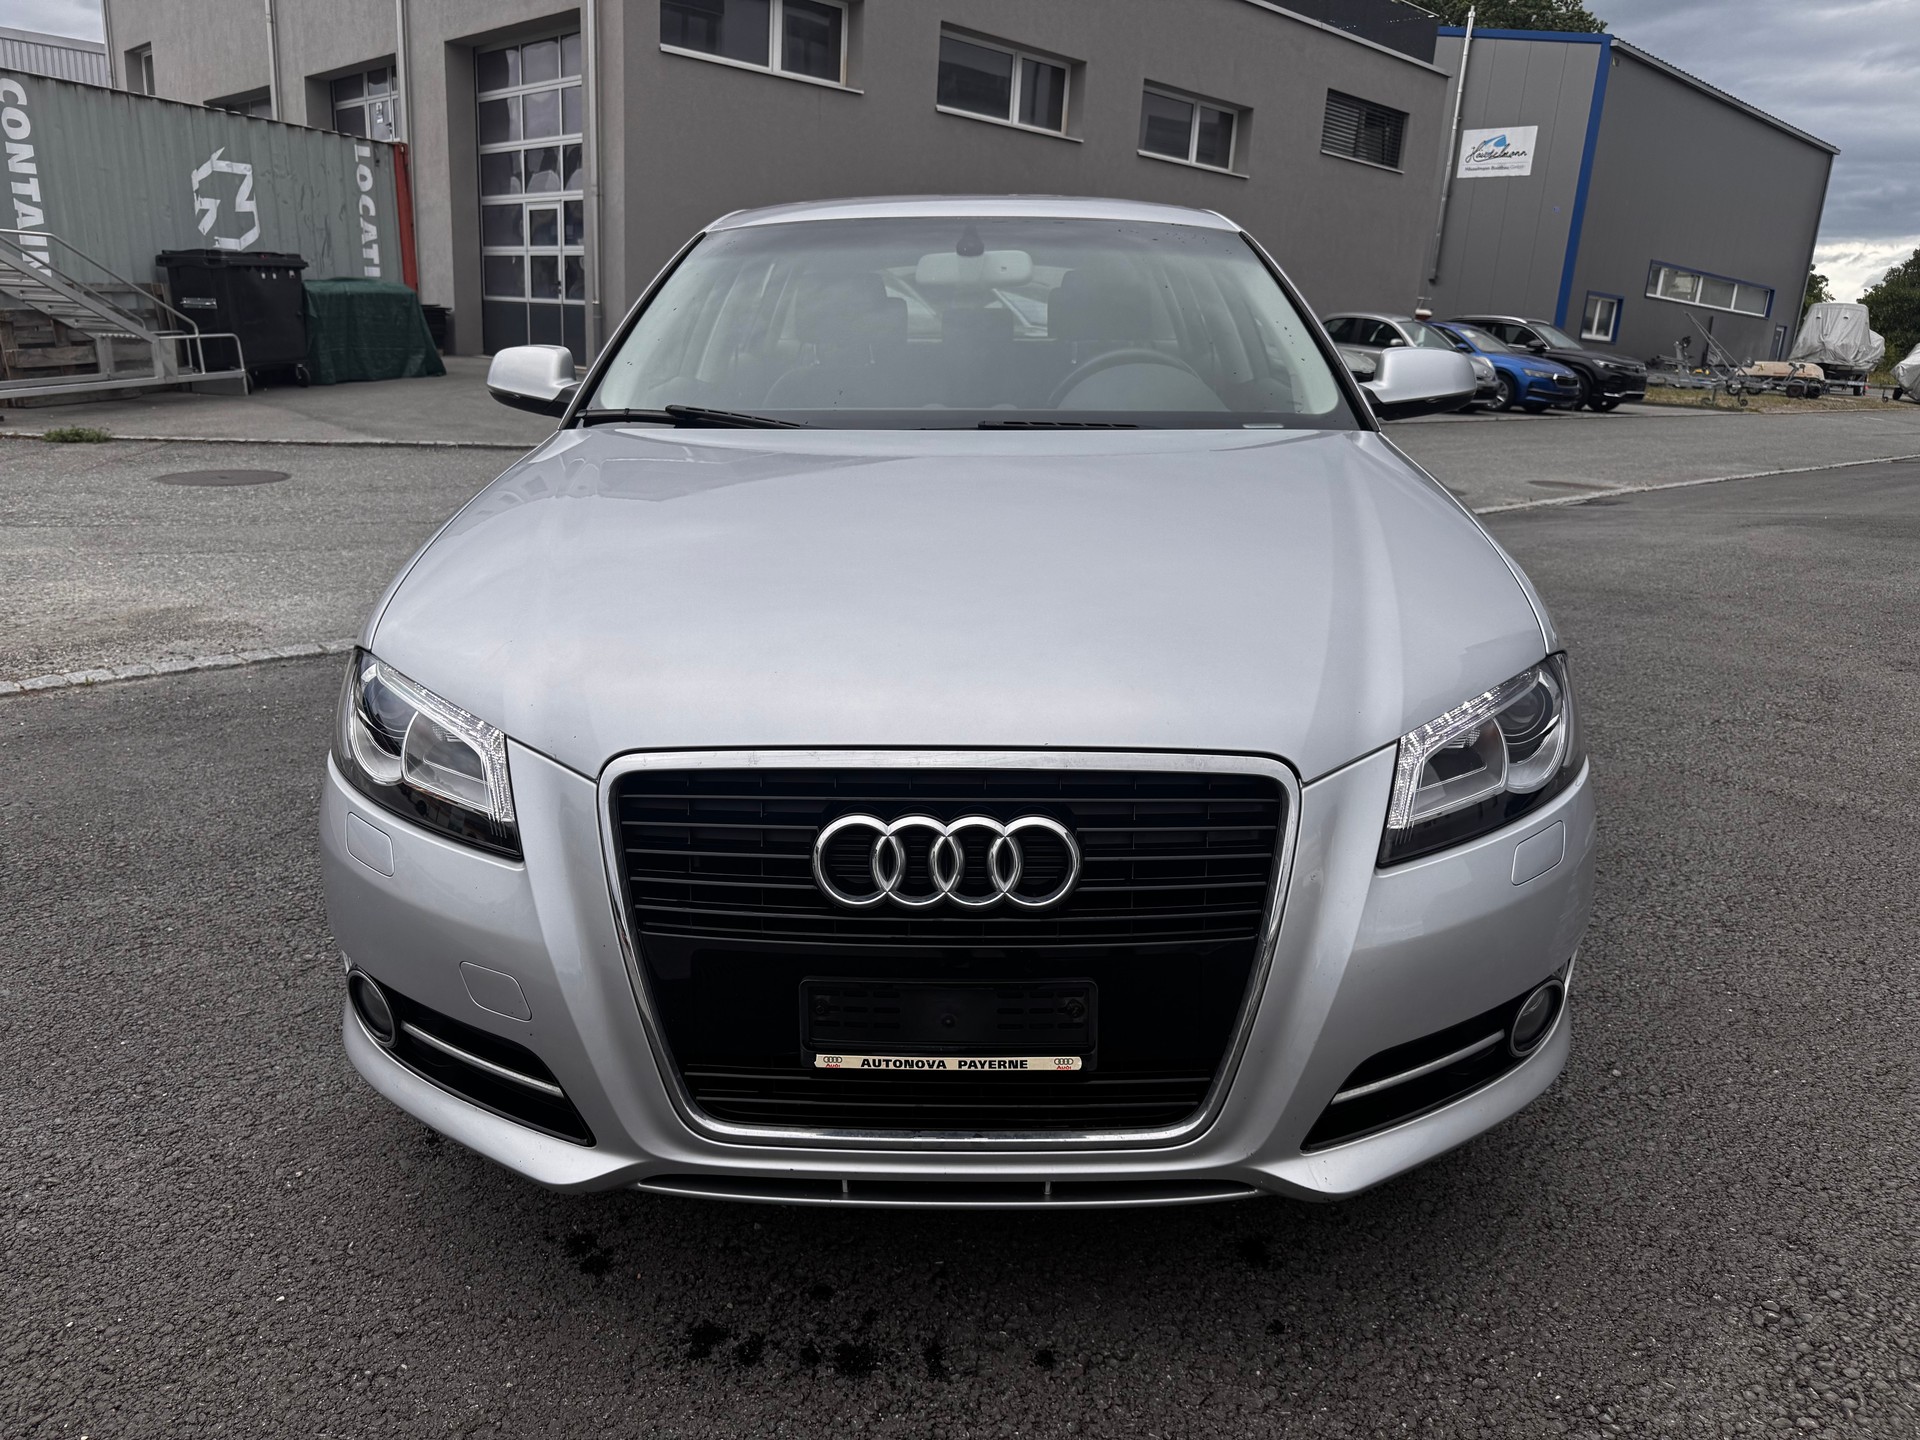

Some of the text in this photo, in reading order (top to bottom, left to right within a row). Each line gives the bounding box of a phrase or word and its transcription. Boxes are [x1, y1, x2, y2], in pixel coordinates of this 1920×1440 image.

[354, 144, 381, 277] LOCATI
[860, 1058, 1029, 1070] AUTONOVA PAYERNE
